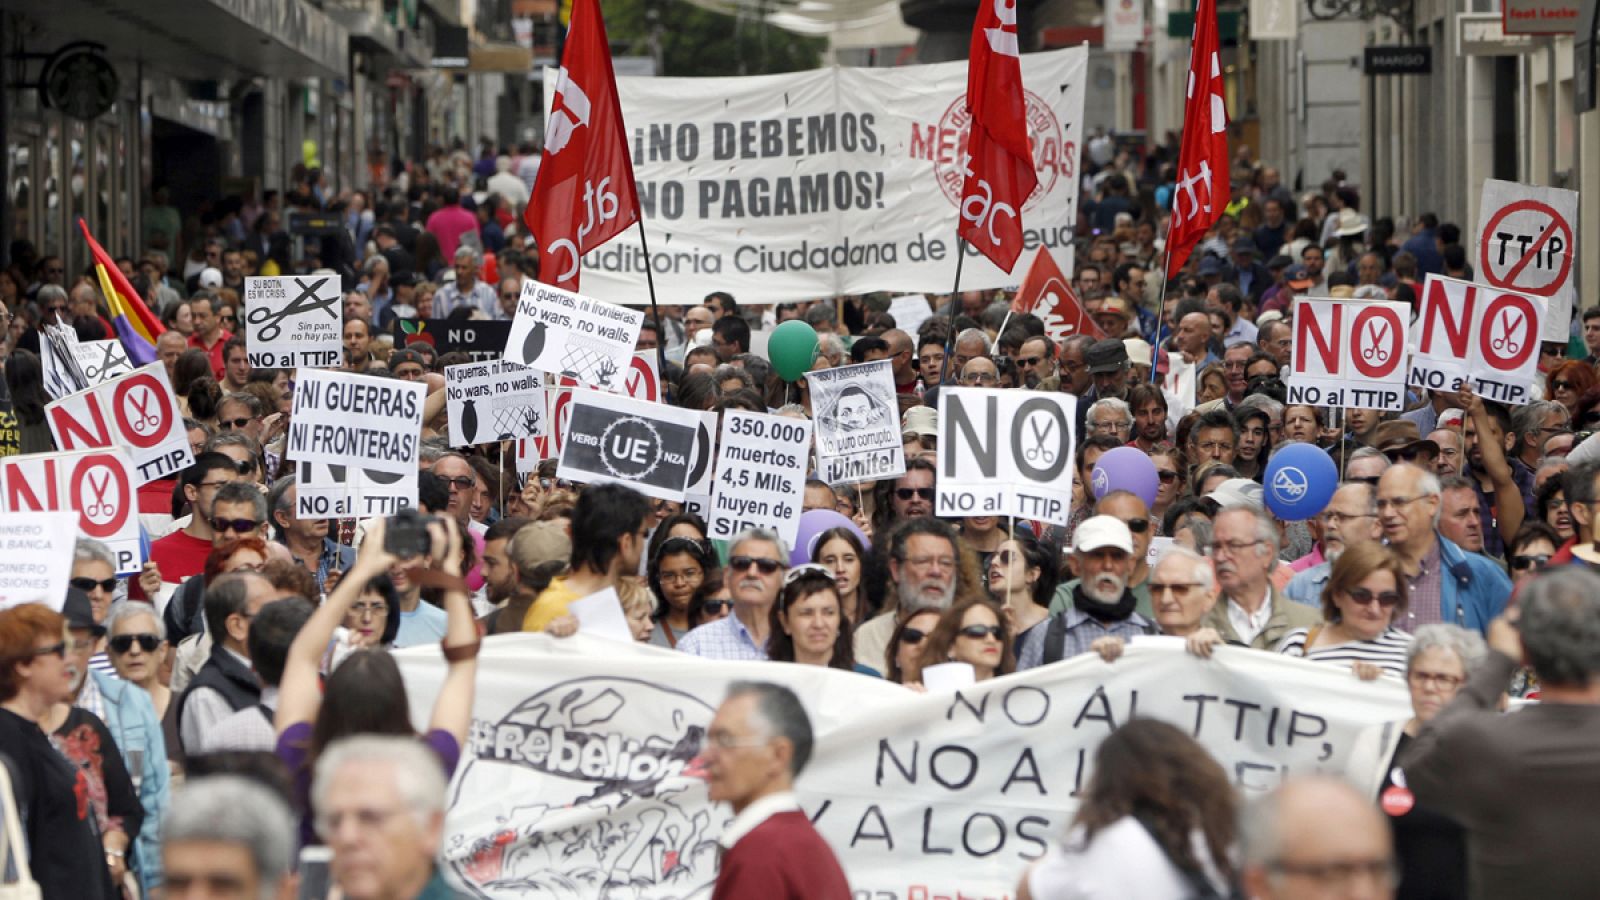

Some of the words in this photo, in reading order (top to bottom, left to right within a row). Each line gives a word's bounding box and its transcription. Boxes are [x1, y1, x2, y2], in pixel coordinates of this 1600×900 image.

[1372, 54, 1424, 67] MANGO
[634, 123, 700, 166] ¡NO
[713, 112, 886, 161] DEBEMOS,
[698, 170, 885, 219] PAGAMOS!
[583, 243, 721, 274] uditoria
[734, 236, 898, 274] Ciudadana
[908, 232, 946, 262] de
[523, 282, 537, 296] Ni
[536, 288, 578, 311] guerras,
[579, 300, 590, 312] ni
[291, 332, 302, 340] no
[304, 332, 320, 341] hay
[298, 322, 312, 331] Sin
[314, 323, 332, 332] pan,
[448, 329, 476, 343] NO
[518, 300, 537, 317] No
[540, 309, 574, 329] wars,
[577, 318, 595, 333] no
[597, 327, 632, 344] walls.
[1420, 279, 1538, 371] NO
[1295, 302, 1404, 378] NO
[248, 352, 275, 367] NO
[280, 352, 295, 367] al
[300, 351, 340, 366] TTIP.
[446, 367, 457, 381] Ni
[457, 364, 490, 384] guerras,
[491, 363, 500, 376] ni
[447, 387, 463, 400] No
[465, 384, 493, 397] wars,
[495, 382, 509, 394] no
[511, 375, 541, 391] walls.
[1289, 387, 1321, 404] NO
[1327, 388, 1345, 406] al
[1351, 388, 1400, 409] TTIP.
[1411, 366, 1446, 389] NO
[1475, 378, 1525, 402] TTIP.
[51, 373, 173, 449] NO
[295, 380, 321, 415] ¡NI
[326, 382, 420, 424] GUERRAS,
[291, 423, 308, 452] NI
[312, 424, 417, 463] FRONTERAS!
[730, 416, 805, 444] 350.000
[944, 393, 1070, 484] NO
[137, 450, 191, 480] TTIP.
[612, 435, 650, 464] UE
[663, 452, 685, 466] NZA
[725, 446, 801, 469] muertos.
[721, 467, 749, 489] 4,5
[826, 448, 896, 485] ¡Dimite!
[6, 454, 130, 538] NO
[300, 496, 329, 514] NO
[717, 492, 768, 516] huyen
[772, 501, 793, 519] de
[941, 492, 975, 511] NO
[983, 493, 1003, 511] al
[1016, 493, 1063, 521] TTIP.
[946, 685, 1050, 727] NO
[1183, 694, 1333, 761] TTIP,
[876, 738, 979, 790] NO
[850, 804, 894, 851] A
[922, 807, 1050, 861] LOS
